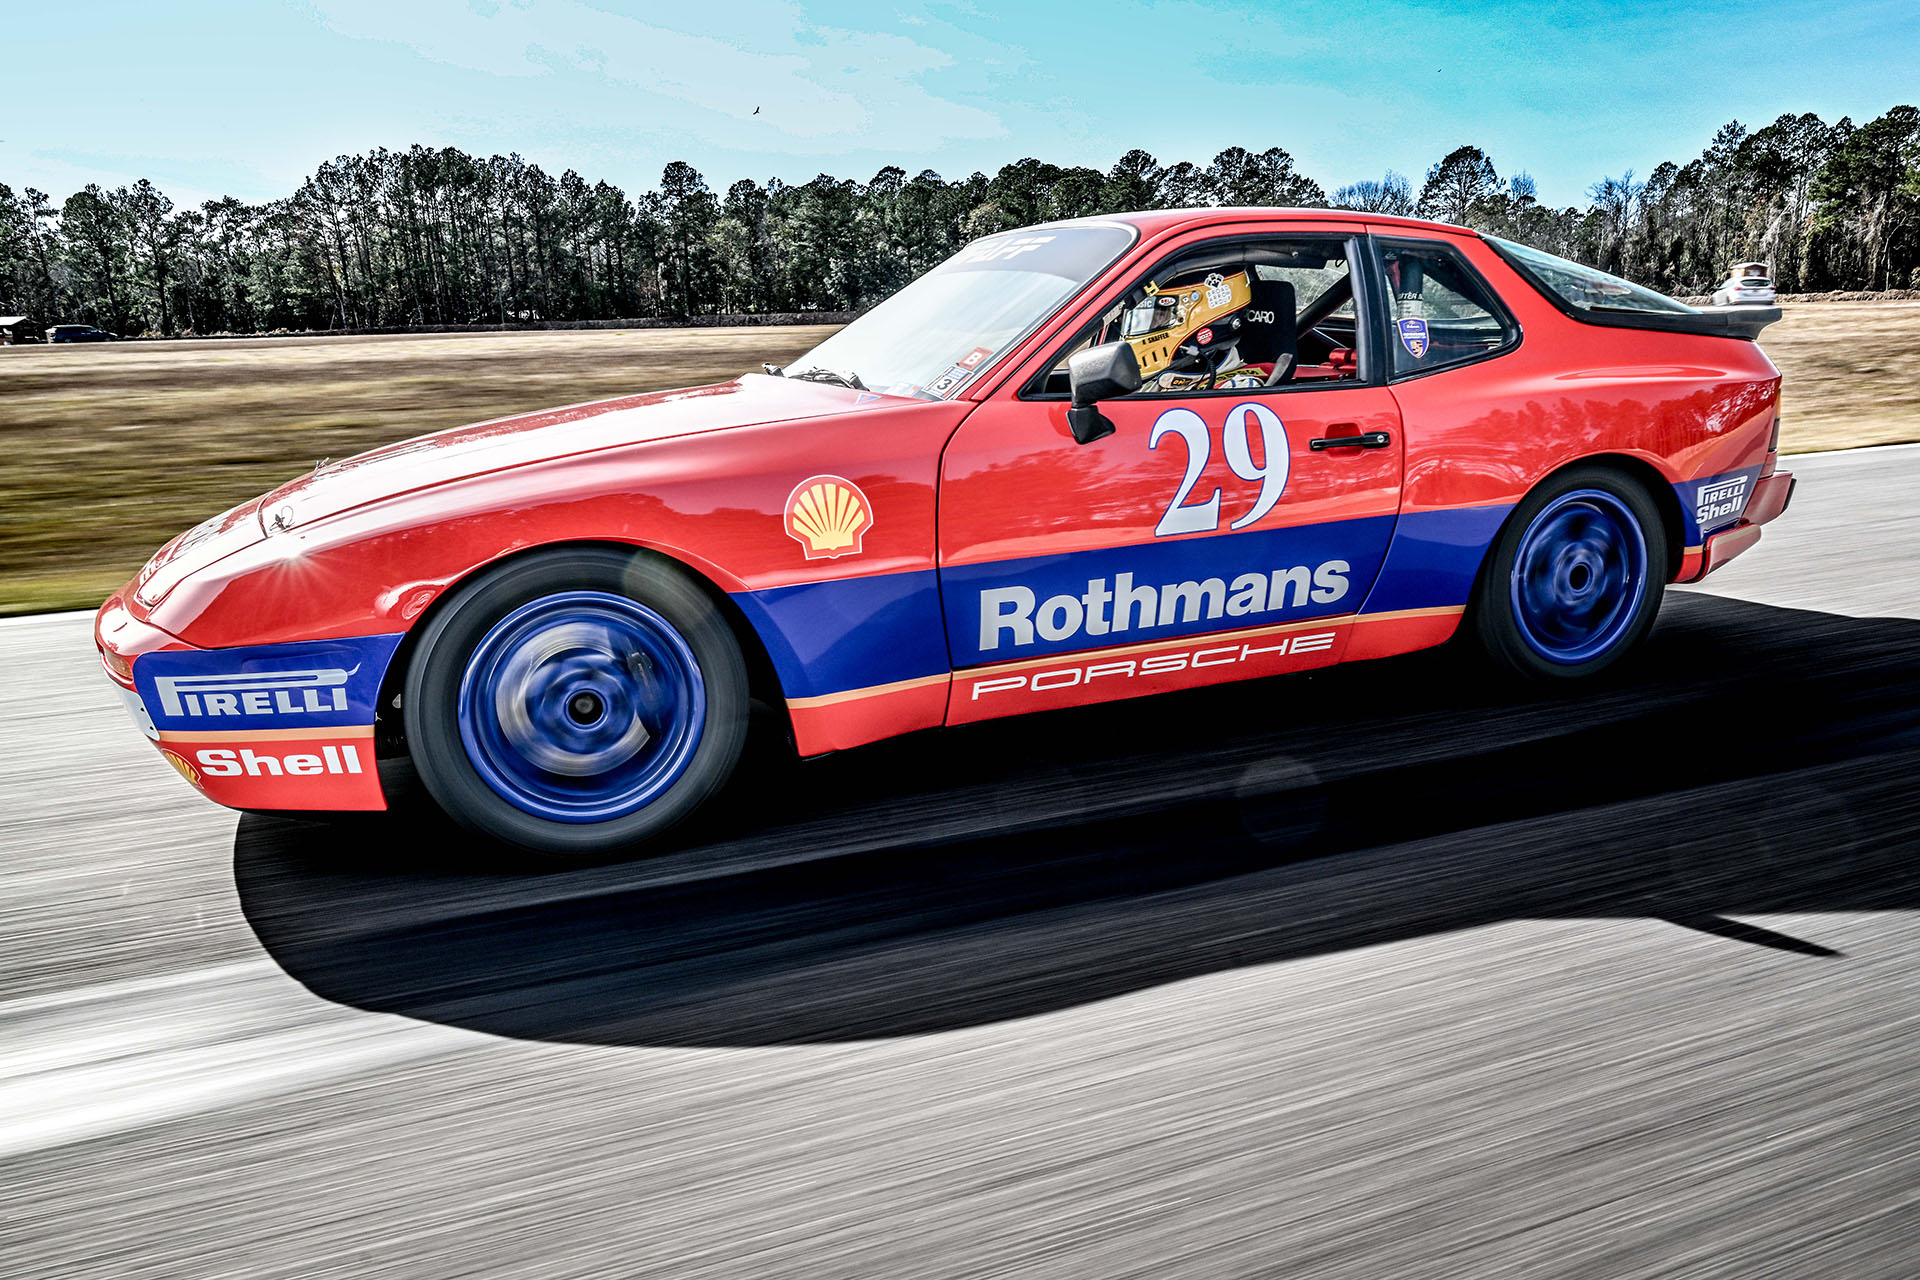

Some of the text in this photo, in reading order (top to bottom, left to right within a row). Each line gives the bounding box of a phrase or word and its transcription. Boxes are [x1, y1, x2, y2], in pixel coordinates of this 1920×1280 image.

[1247, 309, 1275, 324] CARO
[1148, 332, 1169, 343] SHAFFER
[937, 379, 953, 390] 3
[1148, 401, 1291, 537] 29
[1697, 475, 1748, 507] PIRELLI
[1696, 495, 1744, 525] Shell
[979, 559, 1351, 652] Rothmans
[971, 632, 1337, 701] PORSCHE
[154, 663, 361, 717] PIRELLI
[196, 745, 363, 776] Shell
